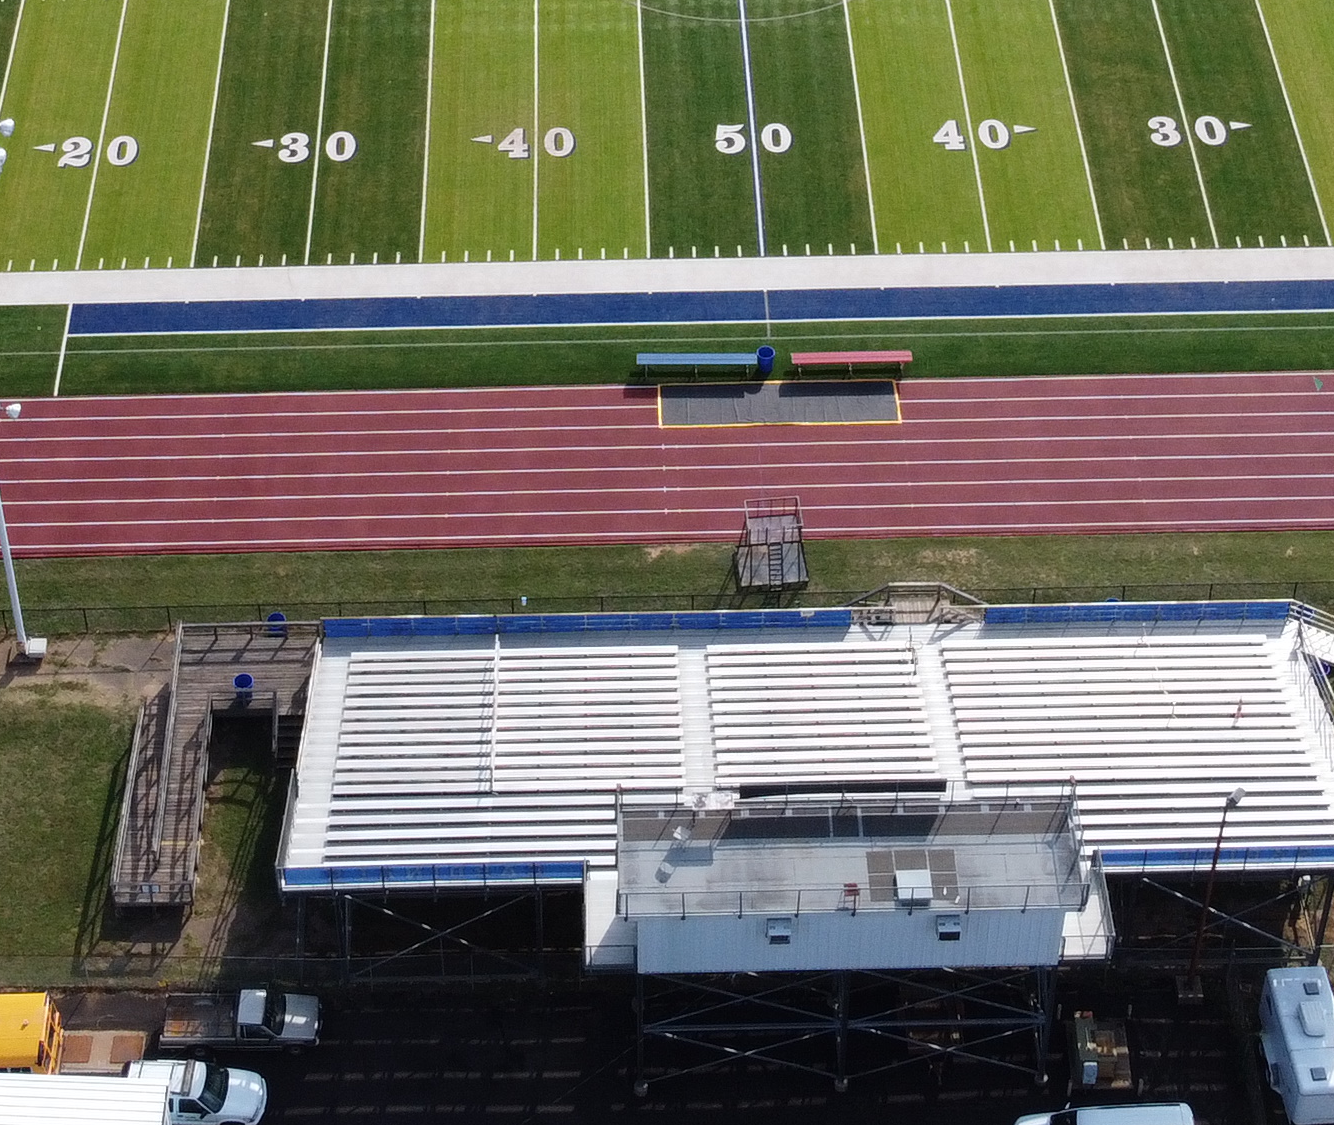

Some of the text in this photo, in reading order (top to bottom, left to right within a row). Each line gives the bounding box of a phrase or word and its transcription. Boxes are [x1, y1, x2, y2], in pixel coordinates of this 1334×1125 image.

[278, 131, 358, 163] 30
[498, 127, 576, 159] 40
[715, 123, 793, 155] 50
[932, 119, 1010, 151] 40
[1148, 116, 1227, 147] 30
[58, 136, 139, 168] 20
